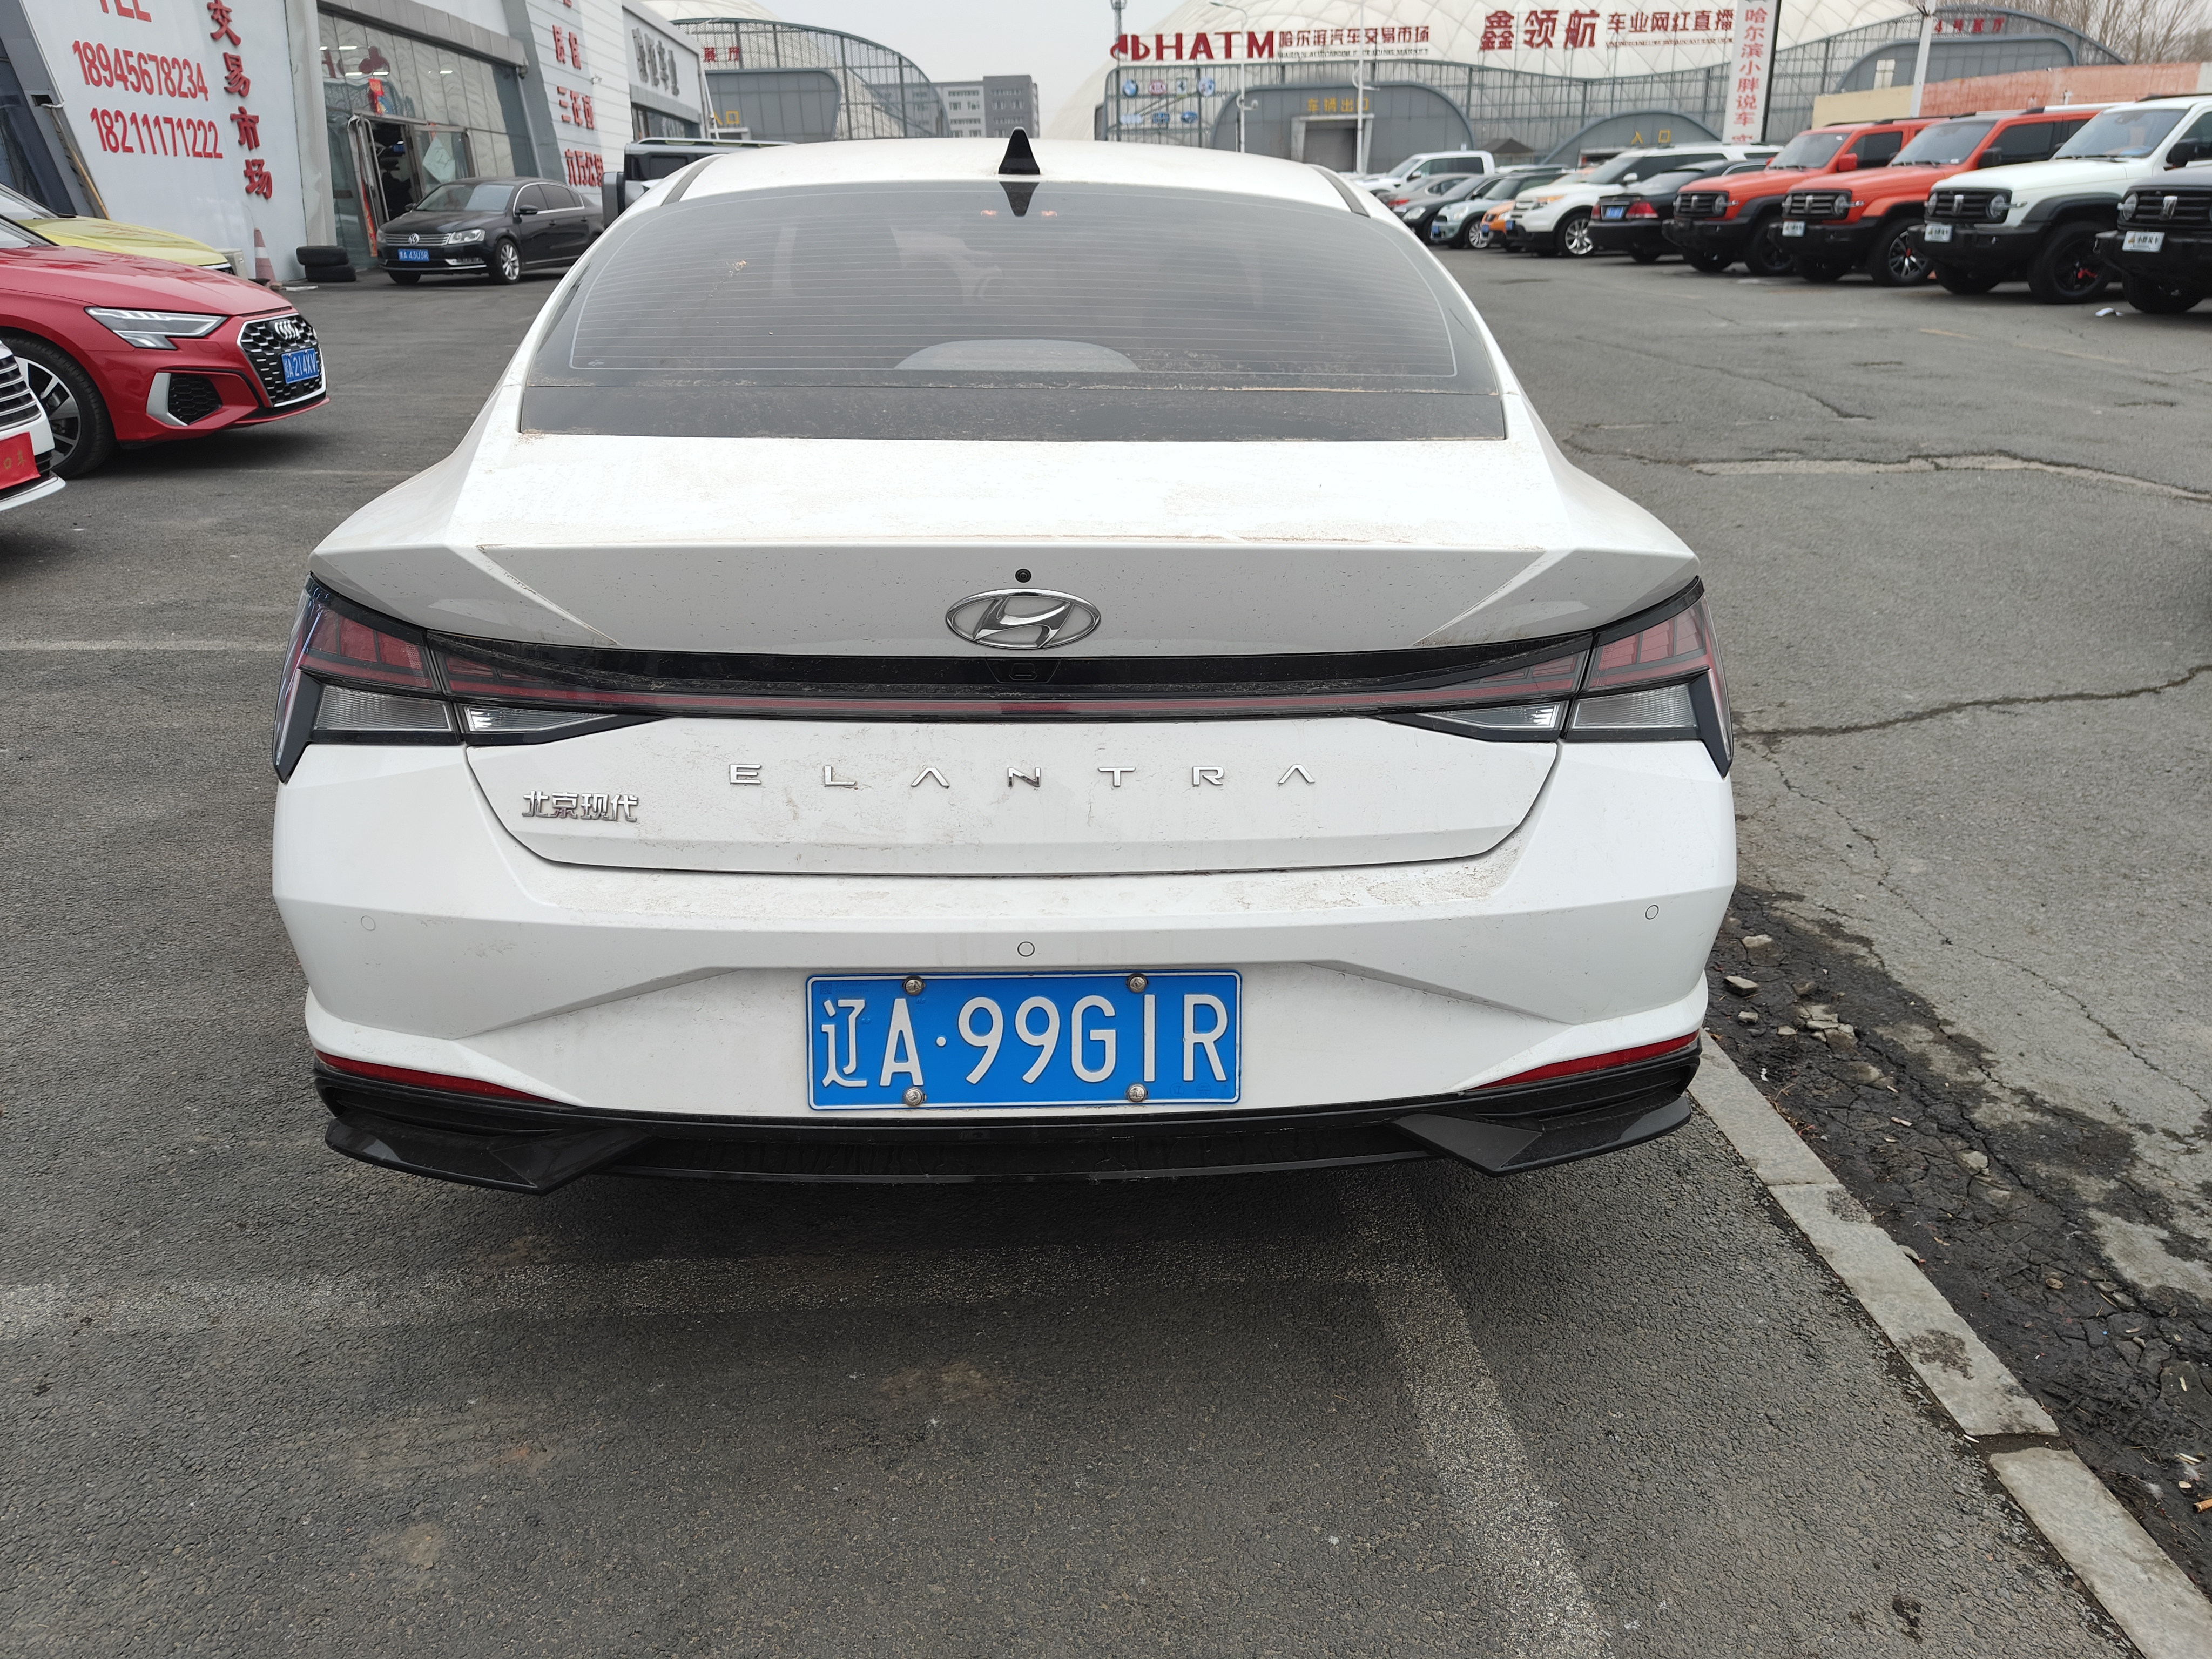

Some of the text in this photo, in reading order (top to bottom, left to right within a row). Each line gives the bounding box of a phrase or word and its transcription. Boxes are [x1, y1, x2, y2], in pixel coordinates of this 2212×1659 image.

[1479, 9, 1600, 50] 鑫领航
[1607, 9, 1734, 33] 车业网红直播
[1155, 31, 1274, 61] HATM
[1279, 26, 1429, 48] 哈尔滨汽车交易市场
[704, 46, 740, 63] 展厅
[1732, 6, 1768, 126] 哈尔滨小胖说车
[72, 39, 209, 102] 18945678234
[207, 0, 272, 199] 交易市场
[1307, 97, 1370, 112] 车辆出口
[90, 107, 224, 159] 18211171222
[1631, 130, 1671, 145] 入口
[729, 763, 1315, 788] ELANTRA
[522, 790, 639, 822] 北京现代
